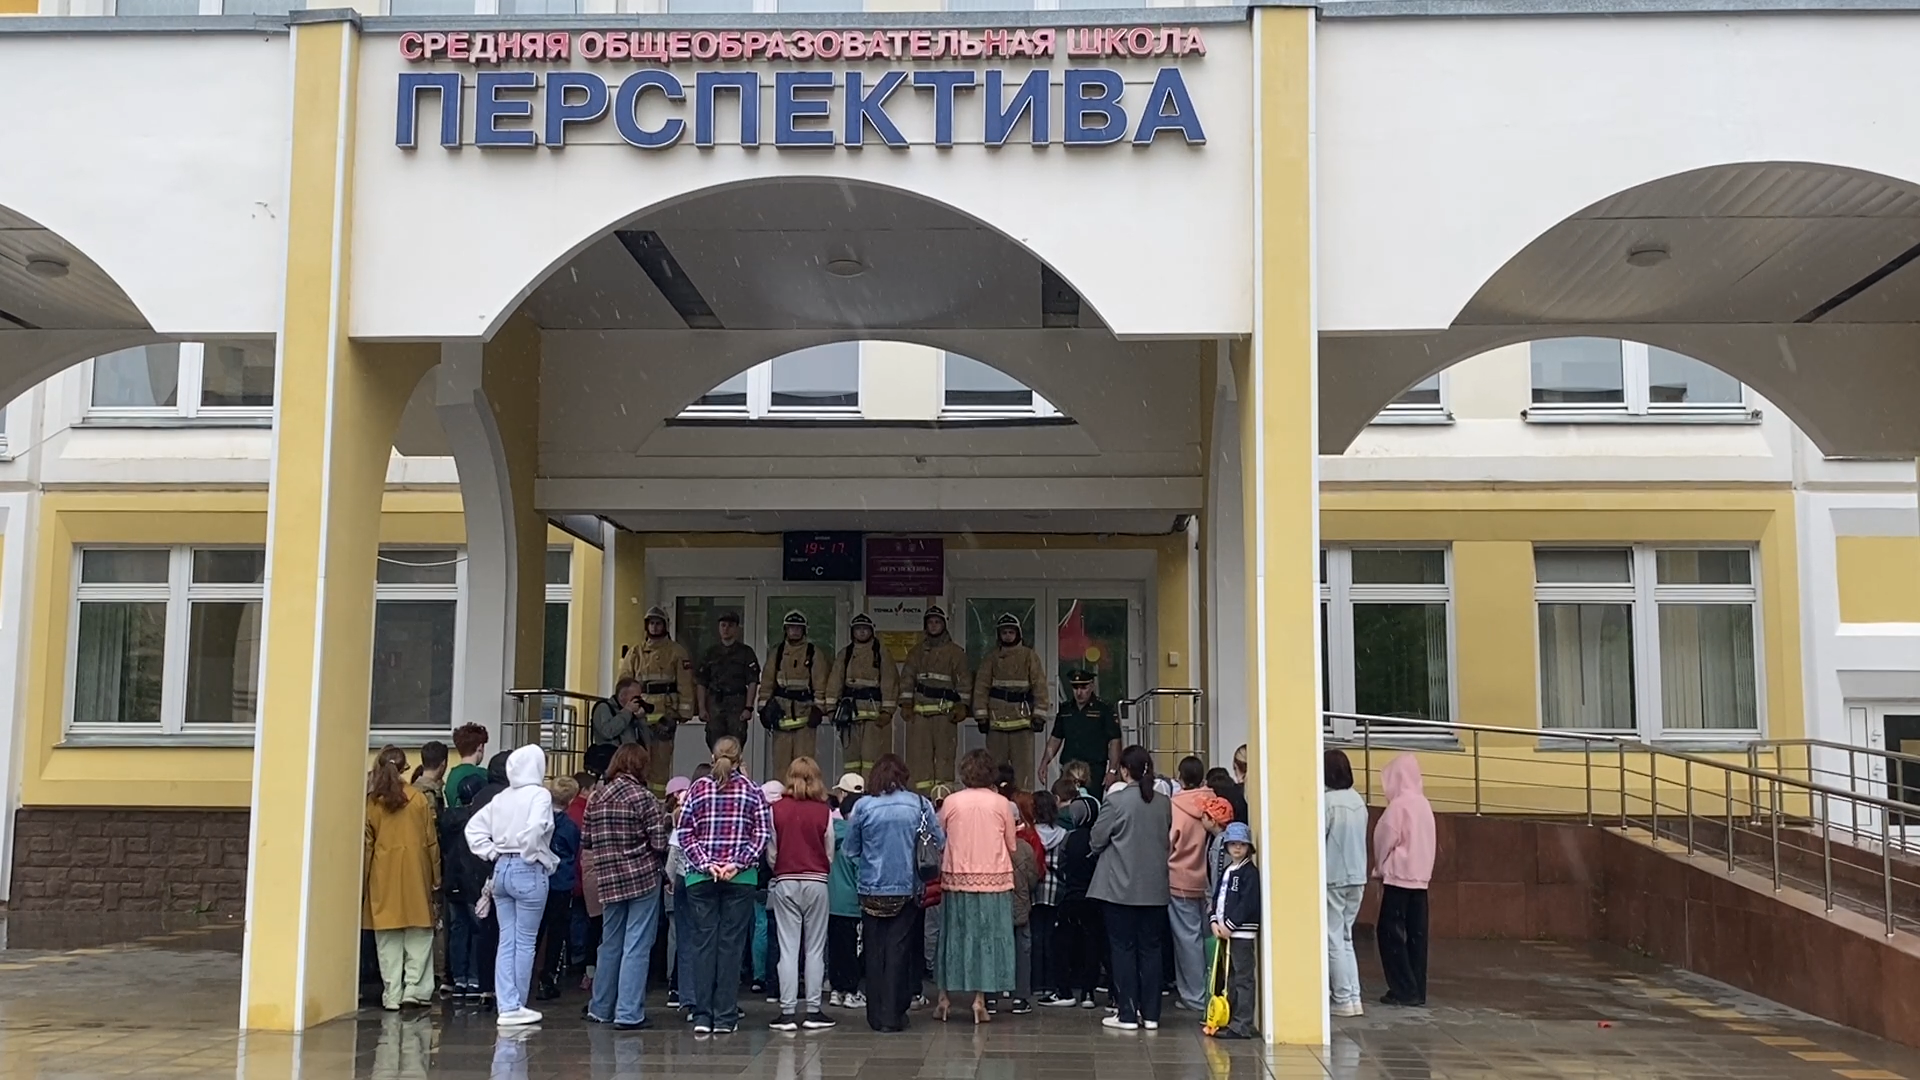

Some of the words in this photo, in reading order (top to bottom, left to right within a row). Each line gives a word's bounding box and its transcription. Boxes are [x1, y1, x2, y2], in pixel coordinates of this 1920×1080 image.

[399, 31, 570, 63] СРЕДНЯЯ
[578, 28, 1056, 63] ОБЩЕОБРАЗОВАТЕЛЬНАЯ
[1066, 26, 1207, 58] ШКОЛА
[395, 66, 1207, 150] ПЕРСПЕКТИВА
